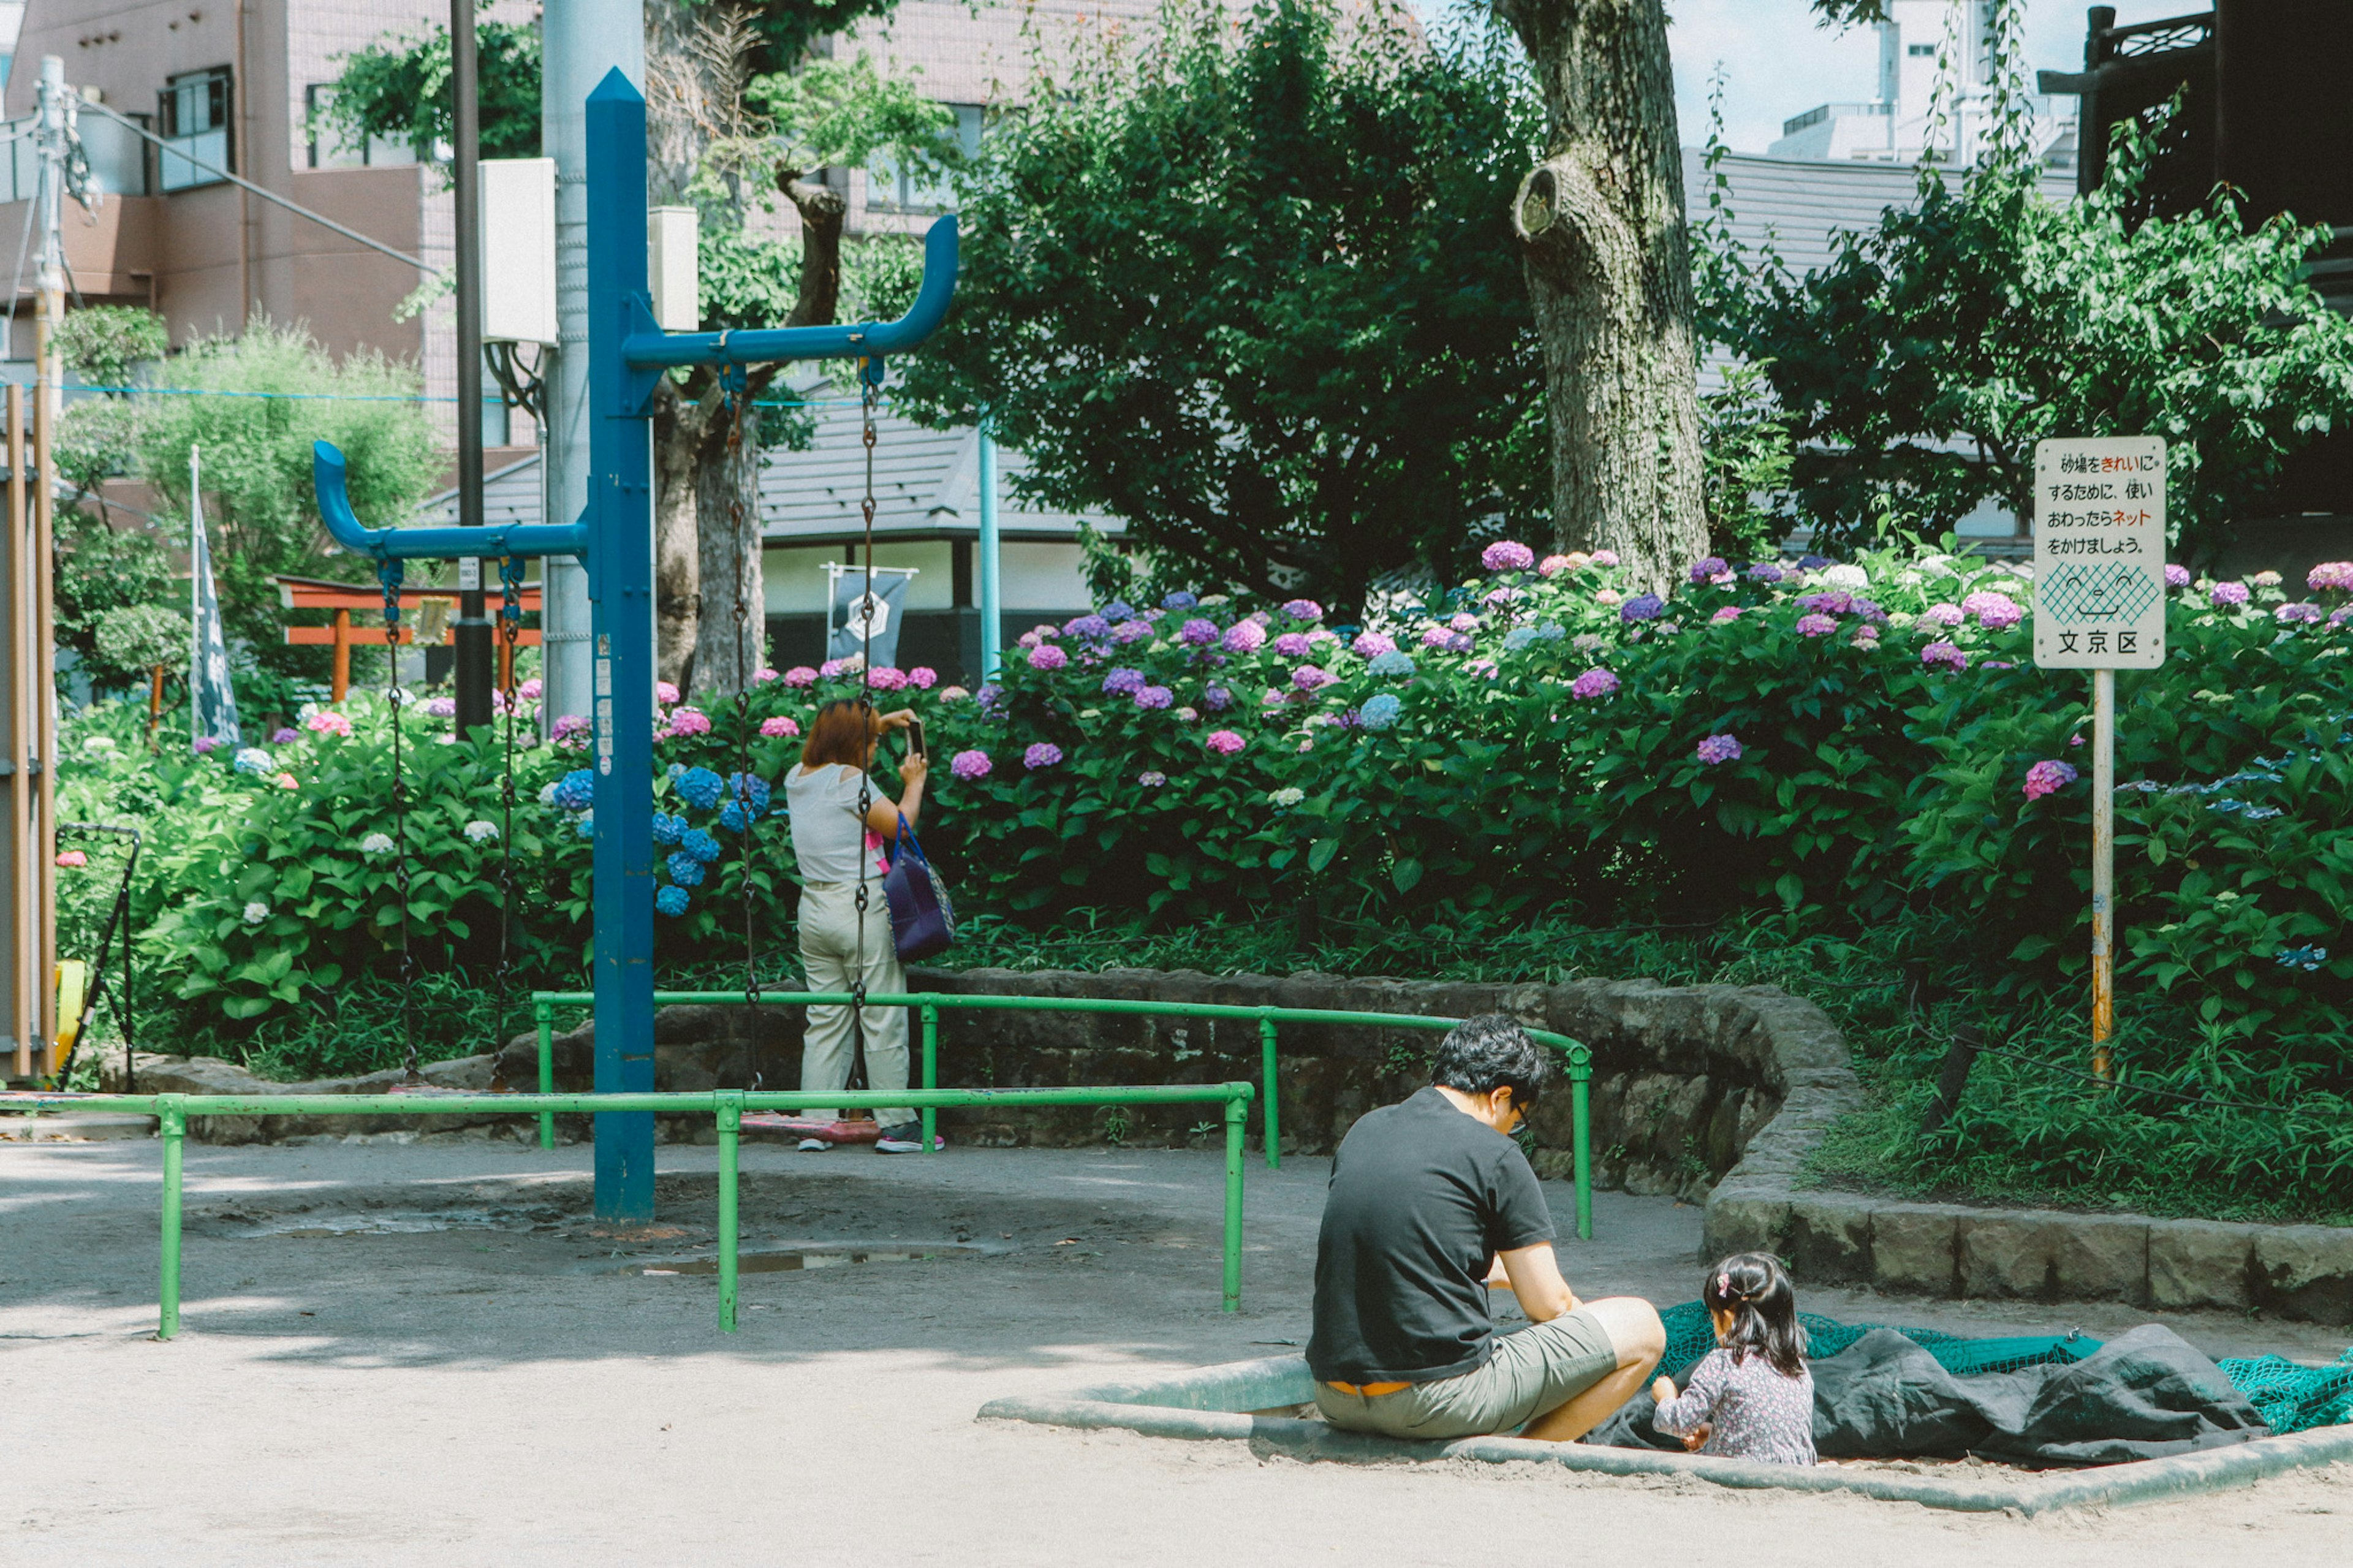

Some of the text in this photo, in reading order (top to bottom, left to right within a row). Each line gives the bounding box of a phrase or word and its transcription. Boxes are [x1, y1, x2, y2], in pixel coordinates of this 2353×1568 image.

[2061, 455, 2154, 474] 砂場をきれいに
[2047, 482, 2153, 501] するために、使い
[2047, 509, 2151, 528] おわったらネット
[2047, 537, 2143, 555] をかけましょう。
[2058, 629, 2138, 654] 文京区
